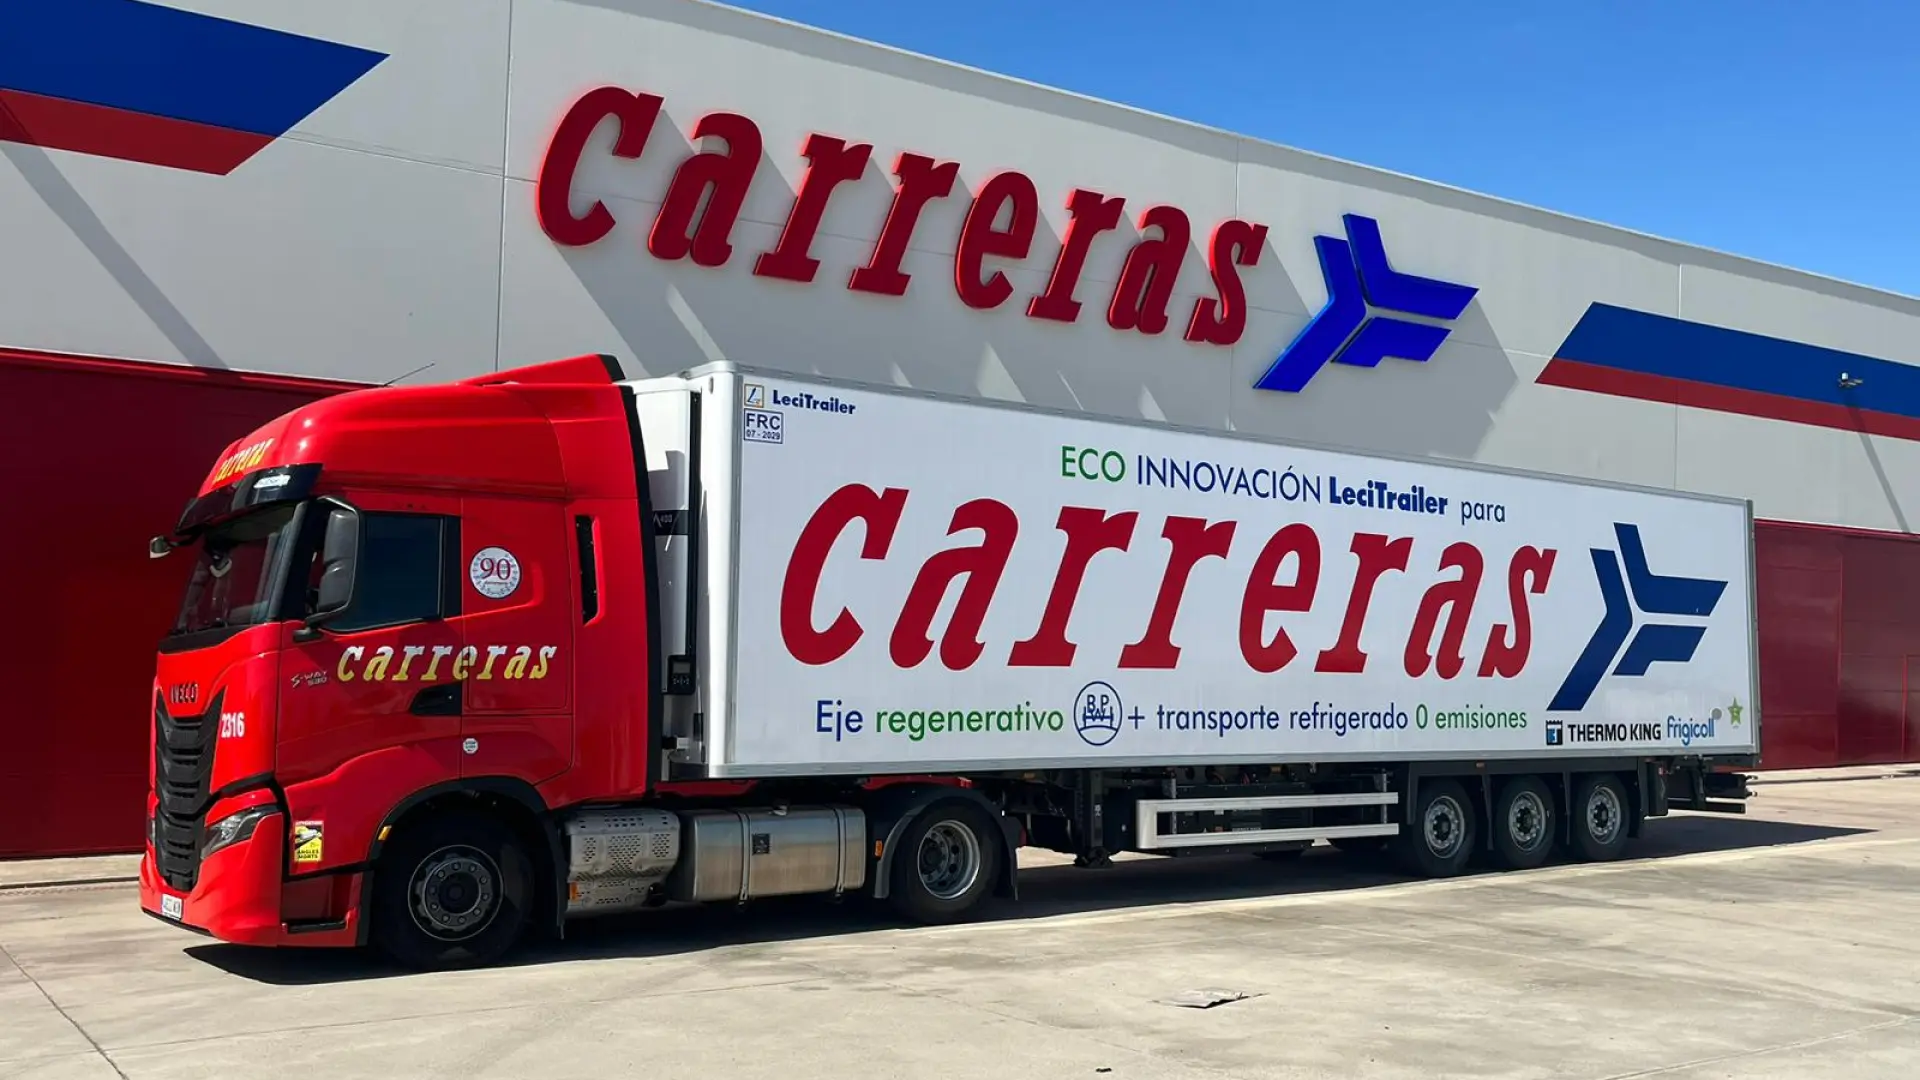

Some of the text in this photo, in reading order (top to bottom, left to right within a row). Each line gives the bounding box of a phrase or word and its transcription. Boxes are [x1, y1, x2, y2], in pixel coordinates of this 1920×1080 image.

[535, 85, 1268, 345] carreras
[773, 389, 856, 415] LeciTrailer
[746, 412, 780, 430] FRC
[1062, 446, 1505, 525] ECO INNOVACIÓN LeciTrailer para
[480, 557, 510, 580] 90
[779, 483, 1558, 679] carreras
[337, 645, 557, 681] carreras
[221, 711, 245, 738] 2316
[816, 700, 864, 741] Eje
[876, 701, 1064, 741] regenerativo
[1157, 704, 1280, 737] transporte
[1290, 702, 1408, 736] refrigerado
[1415, 704, 1428, 730] 0
[1435, 704, 1528, 729] emisiones
[1568, 723, 1661, 742] THERMO KING
[1667, 715, 1716, 746] frigicoll
